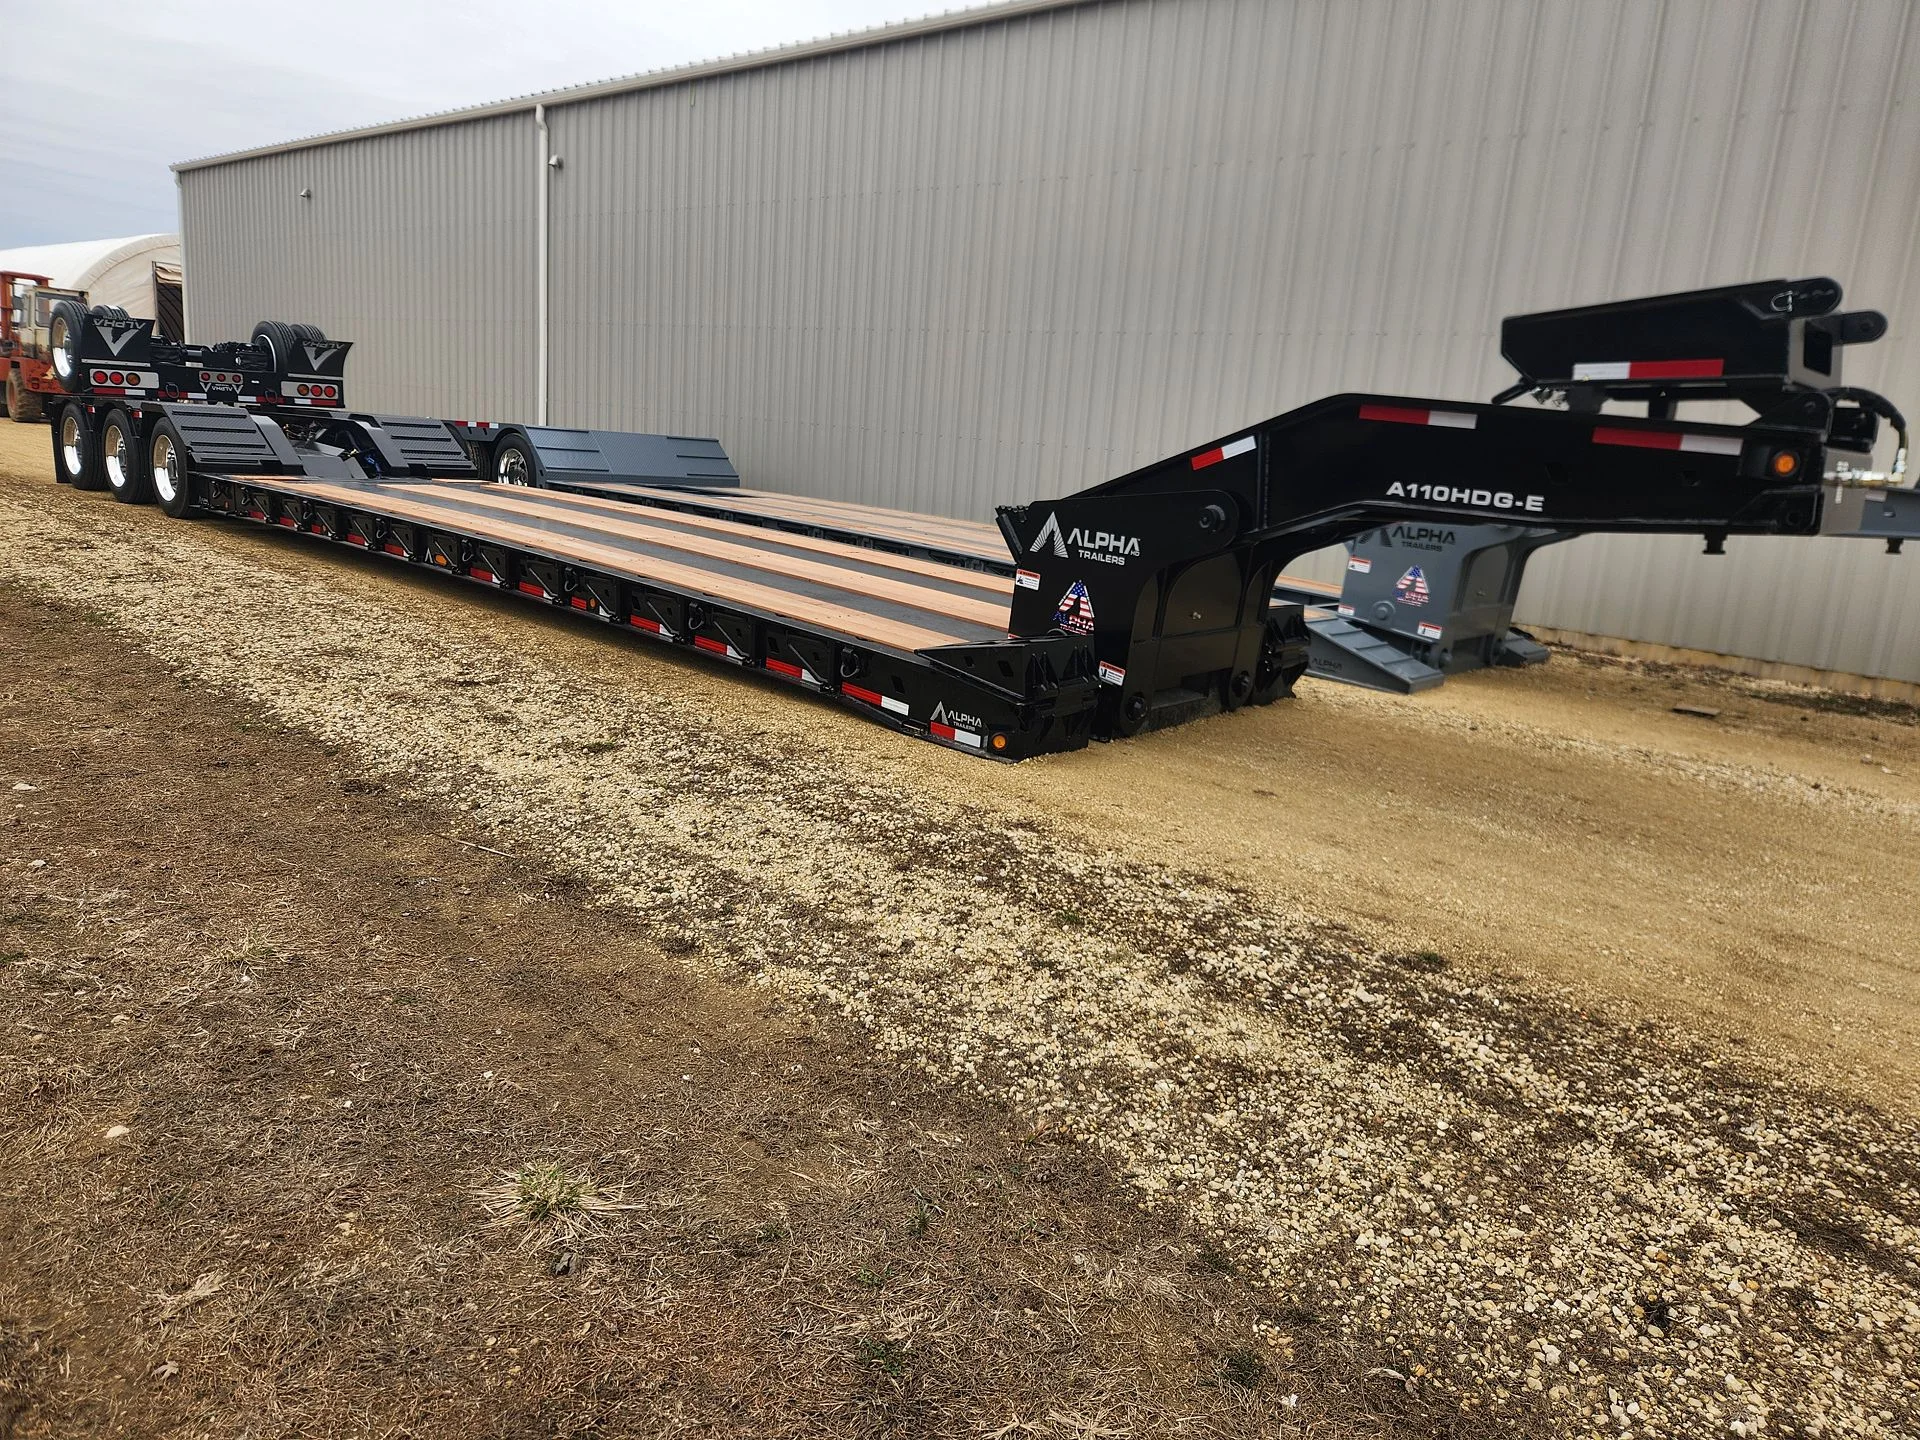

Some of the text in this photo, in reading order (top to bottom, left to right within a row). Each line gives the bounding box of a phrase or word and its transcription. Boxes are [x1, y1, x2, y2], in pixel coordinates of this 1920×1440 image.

[93, 319, 146, 330] ALPHA
[302, 341, 345, 349] ALPHA
[1385, 481, 1545, 512] A110HDG-E
[1066, 527, 1139, 555] ALPHA
[1392, 525, 1456, 545] ALPHA
[1401, 540, 1443, 552] TRAILERS
[1078, 549, 1125, 566] TRAILERS
[948, 710, 982, 728] ALPHA
